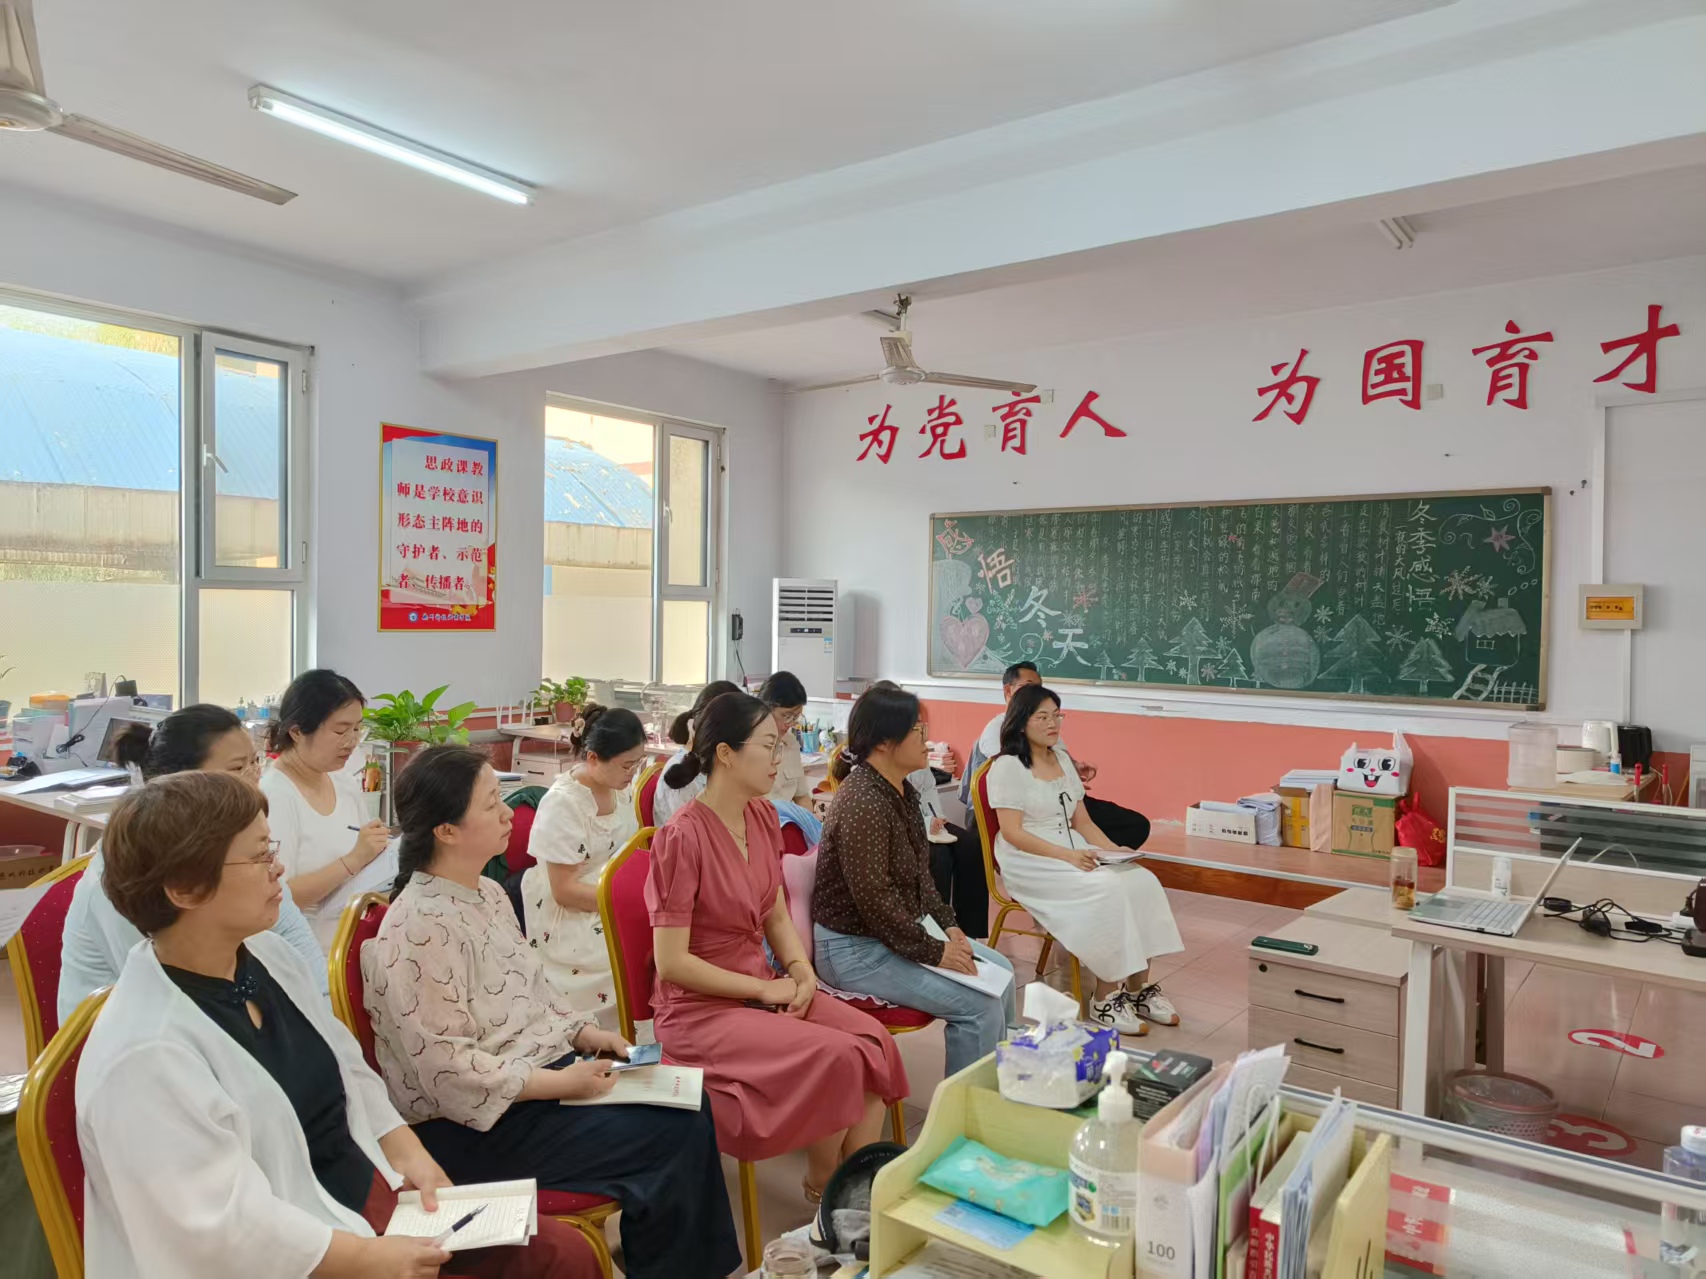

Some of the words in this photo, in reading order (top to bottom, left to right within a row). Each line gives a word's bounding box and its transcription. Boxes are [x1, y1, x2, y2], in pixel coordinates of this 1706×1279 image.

[1253, 304, 1680, 425] 为国育才
[857, 391, 1127, 465] 为党育人
[424, 455, 484, 477] 思政课教
[396, 481, 484, 504] 师是学校意识
[396, 512, 484, 534] 形态主阵地的
[396, 543, 484, 564] 守护者、示范
[1405, 499, 1440, 613] 冬季感悟
[397, 572, 474, 592] 者、传播者。
[1146, 1240, 1176, 1261] 100
